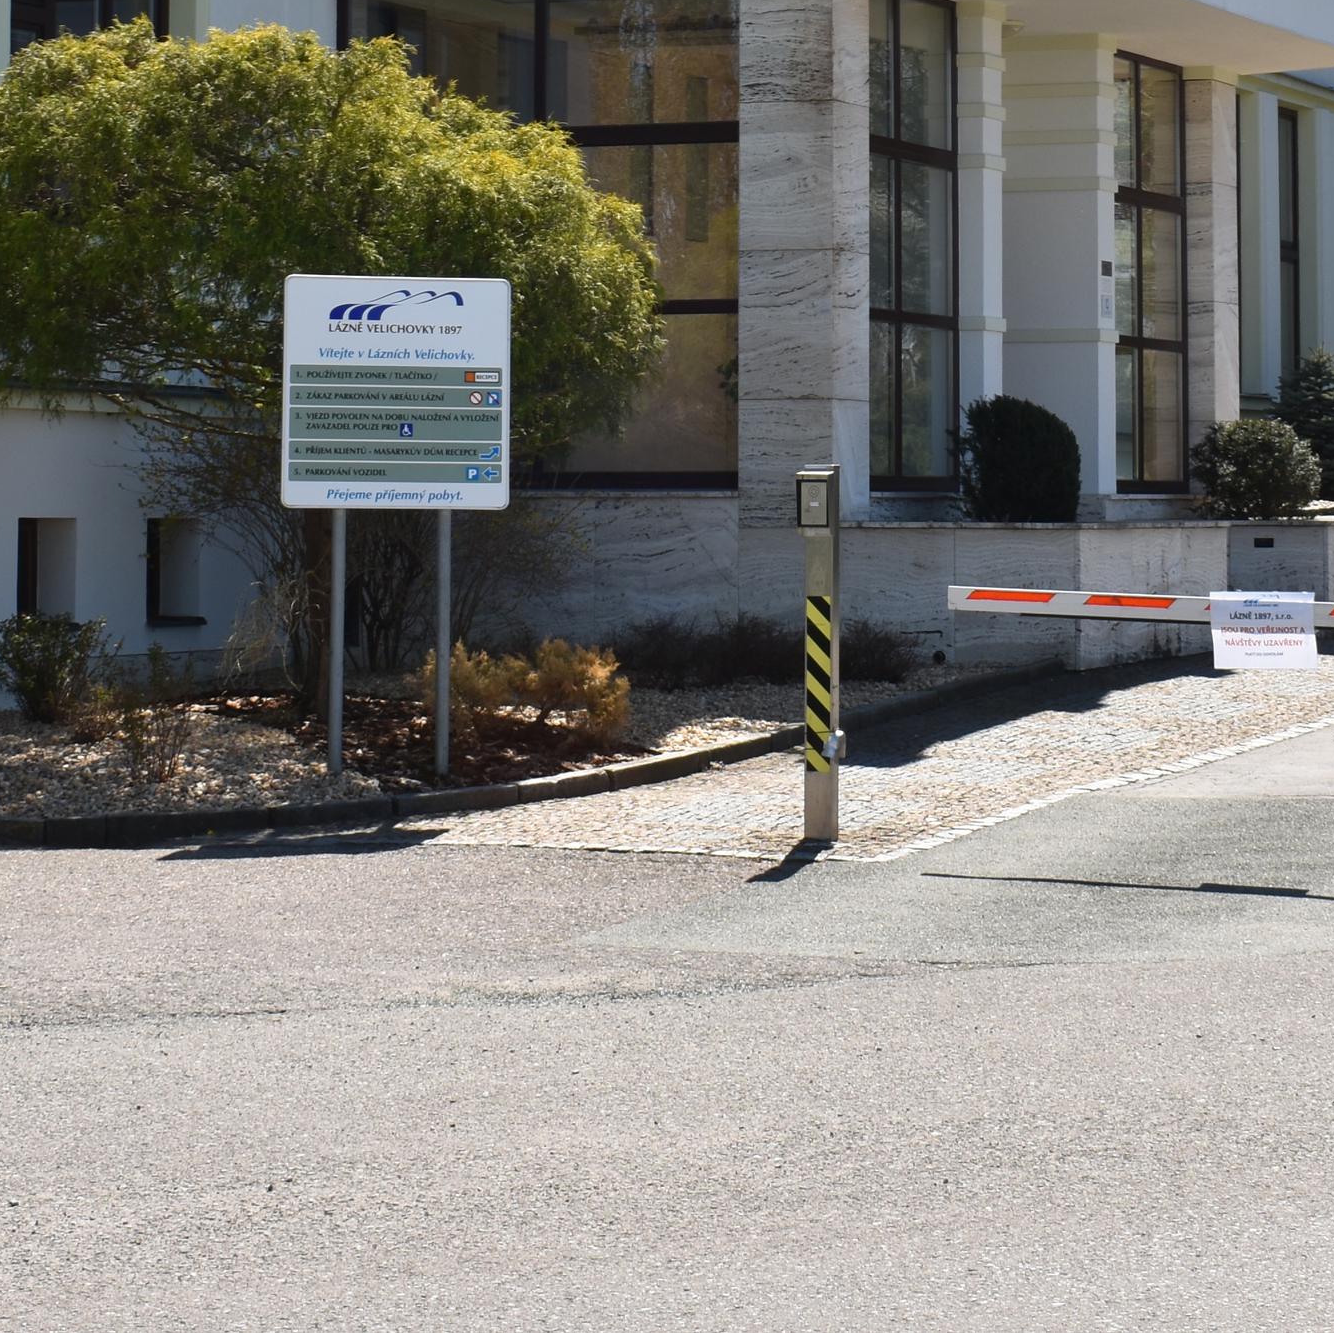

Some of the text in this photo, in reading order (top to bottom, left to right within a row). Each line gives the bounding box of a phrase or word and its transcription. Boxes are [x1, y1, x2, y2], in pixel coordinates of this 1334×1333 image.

[329, 321, 463, 335] LÁZNĚ VELICHOVKY 1897
[319, 347, 354, 360] Vítejte
[368, 348, 411, 359] Lázních
[415, 349, 475, 362] Velichovky.
[307, 369, 352, 379] POUŽÍVEJTE
[355, 371, 387, 379] ZVONEK
[395, 371, 432, 379] TLAČÍTKO
[307, 391, 332, 399] ZÁKAZ
[334, 391, 379, 400] PARKOVÁNÍ
[389, 392, 419, 401] AREÁLU
[421, 393, 444, 401] LÁZNÍ
[307, 413, 329, 421] VJEZD
[411, 413, 451, 421] NALOŽENÍ
[461, 413, 499, 422] VYLOŽENÍ
[381, 423, 398, 431] PRO
[305, 445, 331, 455] PŘÍJEM
[333, 446, 366, 454] KLIENTŮ
[423, 447, 443, 455] DŮM
[445, 448, 477, 456] RECEPCE
[305, 467, 351, 475] PARKOVÁNÍ
[327, 489, 463, 503] Přejeme příjemný pobyt.
[1229, 611, 1252, 620] LÁZNĚ
[1254, 613, 1273, 621] 1897,
[1257, 625, 1297, 634] VEŘEJNOST
[1225, 637, 1303, 647] NÁVŠTĚVY UZAVŘENY
